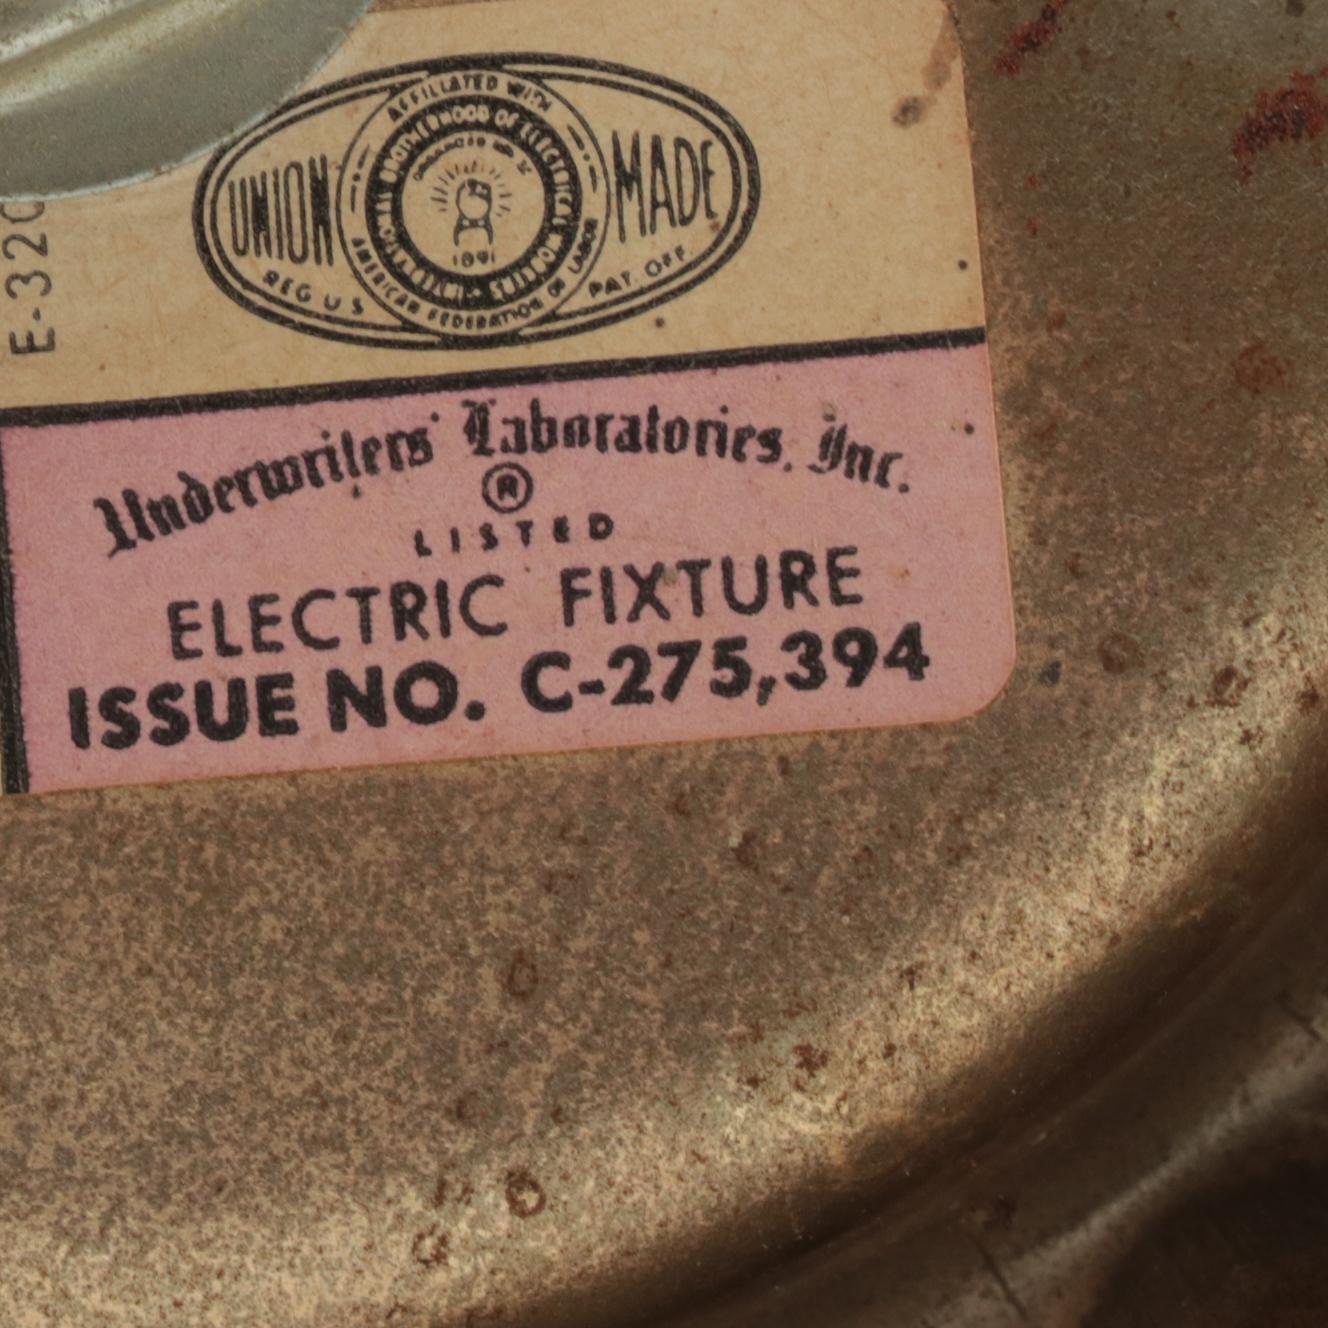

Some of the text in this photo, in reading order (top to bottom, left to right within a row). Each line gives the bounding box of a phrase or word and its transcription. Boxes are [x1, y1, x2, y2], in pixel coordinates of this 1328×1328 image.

[228, 154, 334, 267] UNION
[612, 129, 720, 244] MADE
[413, 512, 615, 558] LISTED
[167, 545, 864, 660] ELECTRIC FIXTURE
[67, 622, 931, 751] ISSUE NO. C-275,394
